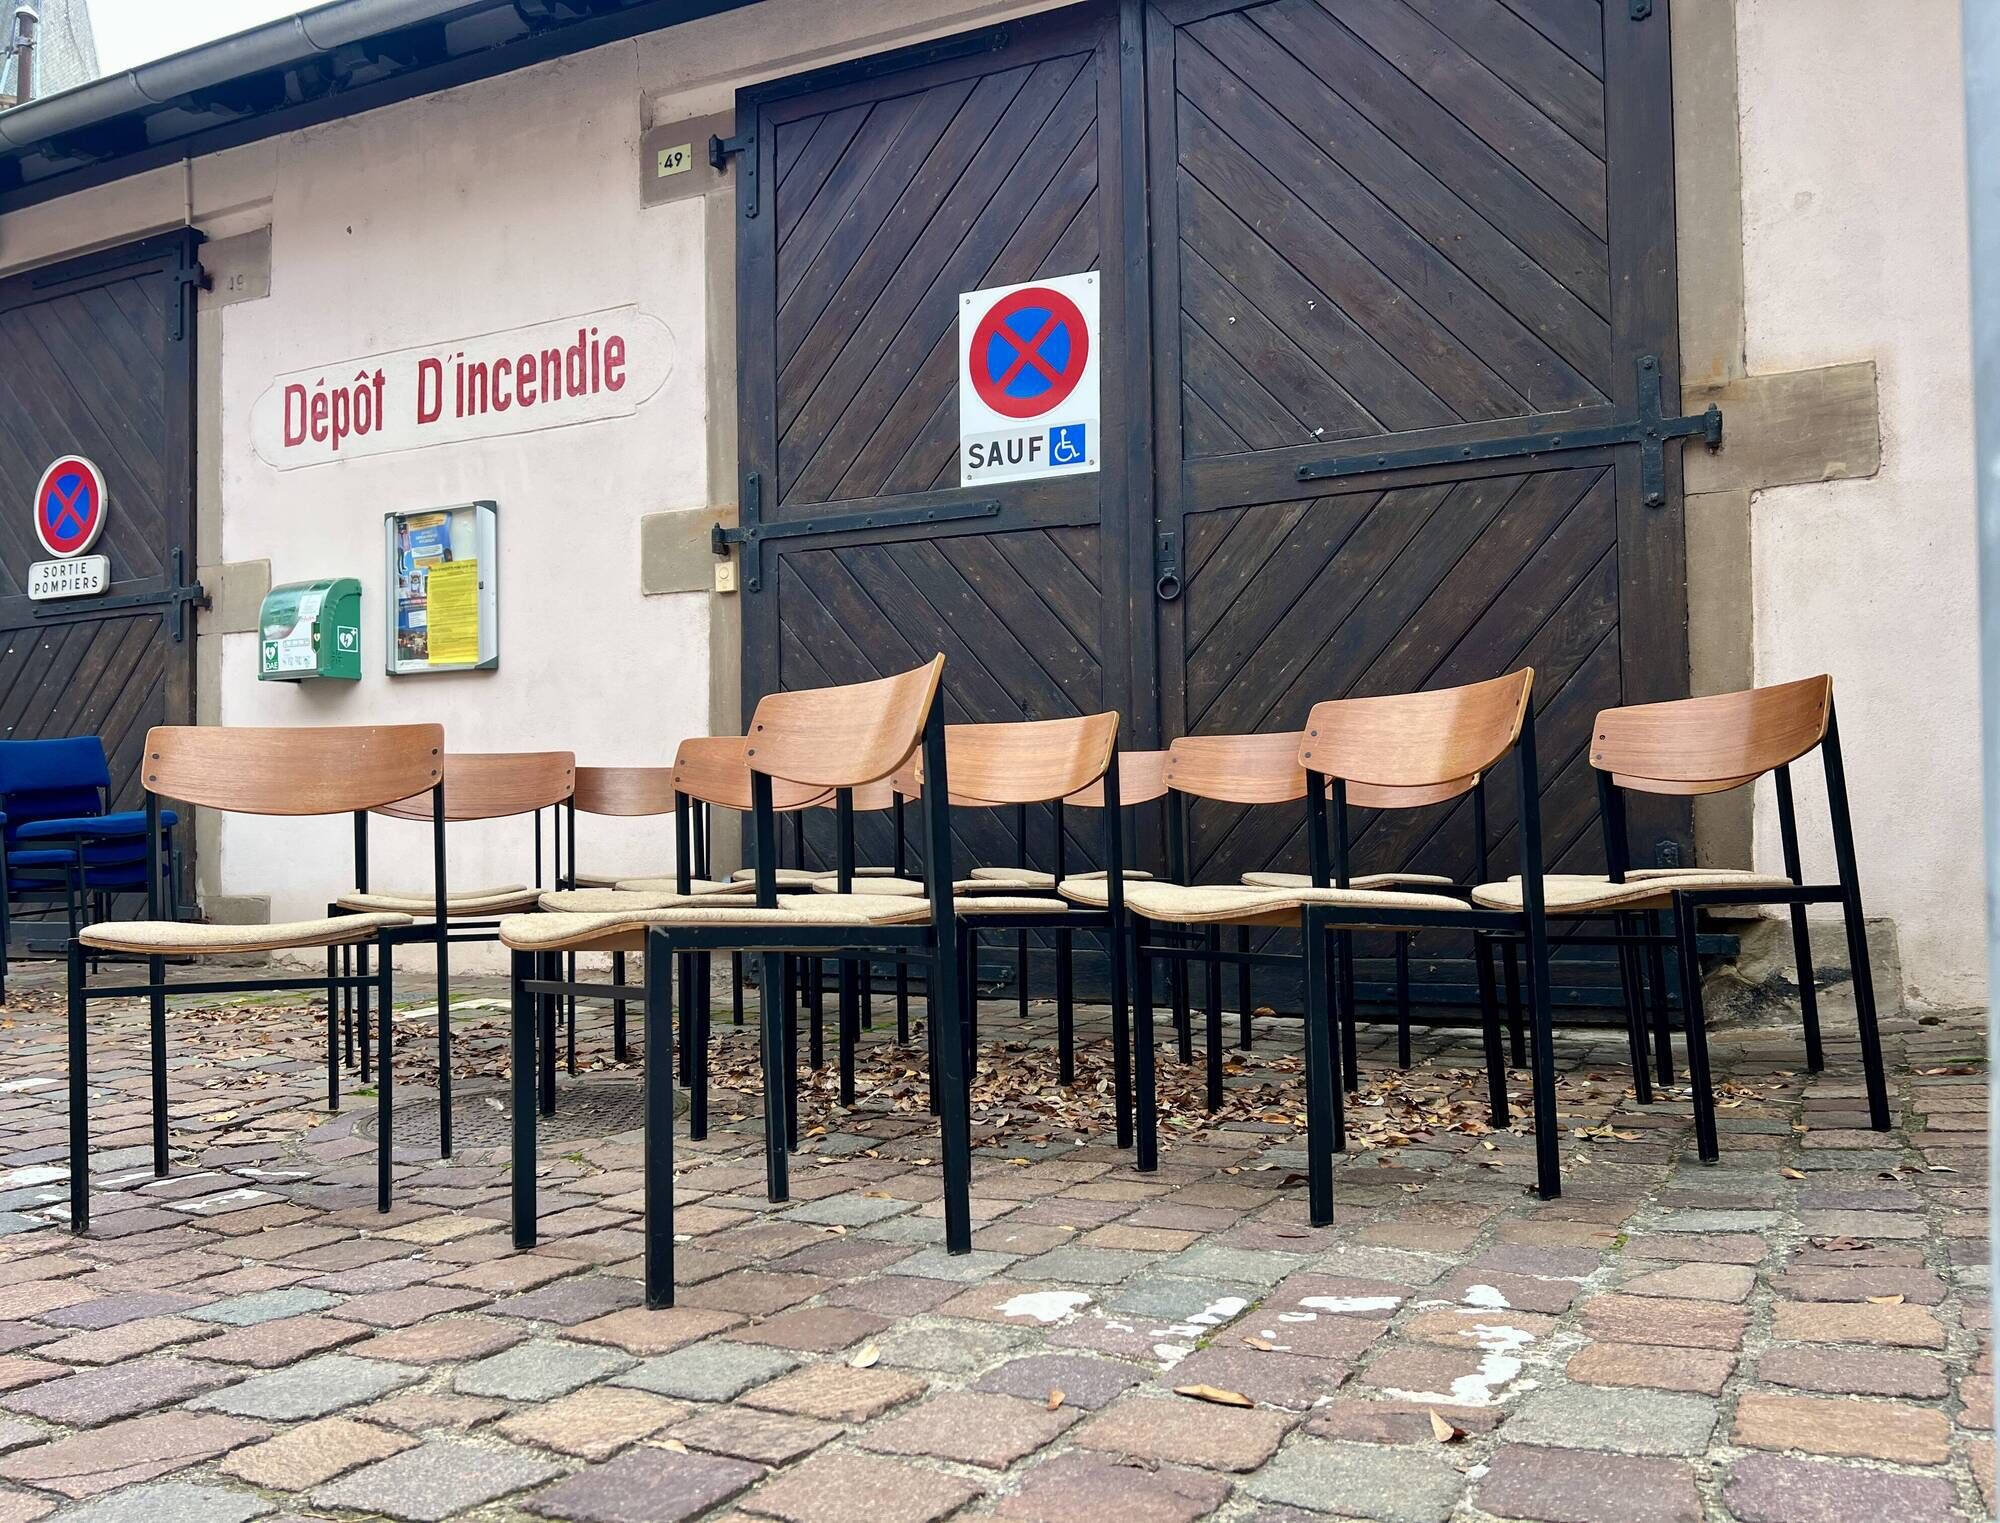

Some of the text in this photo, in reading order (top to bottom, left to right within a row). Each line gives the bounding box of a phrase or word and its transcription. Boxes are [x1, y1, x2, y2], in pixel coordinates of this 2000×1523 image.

[664, 152, 683, 168] 49
[284, 327, 626, 451] Dépôt D'incendie
[968, 435, 1044, 469] SAUF
[44, 562, 87, 578] SORTIE
[34, 576, 98, 594] POMPIERS
[266, 661, 278, 670] DAE
